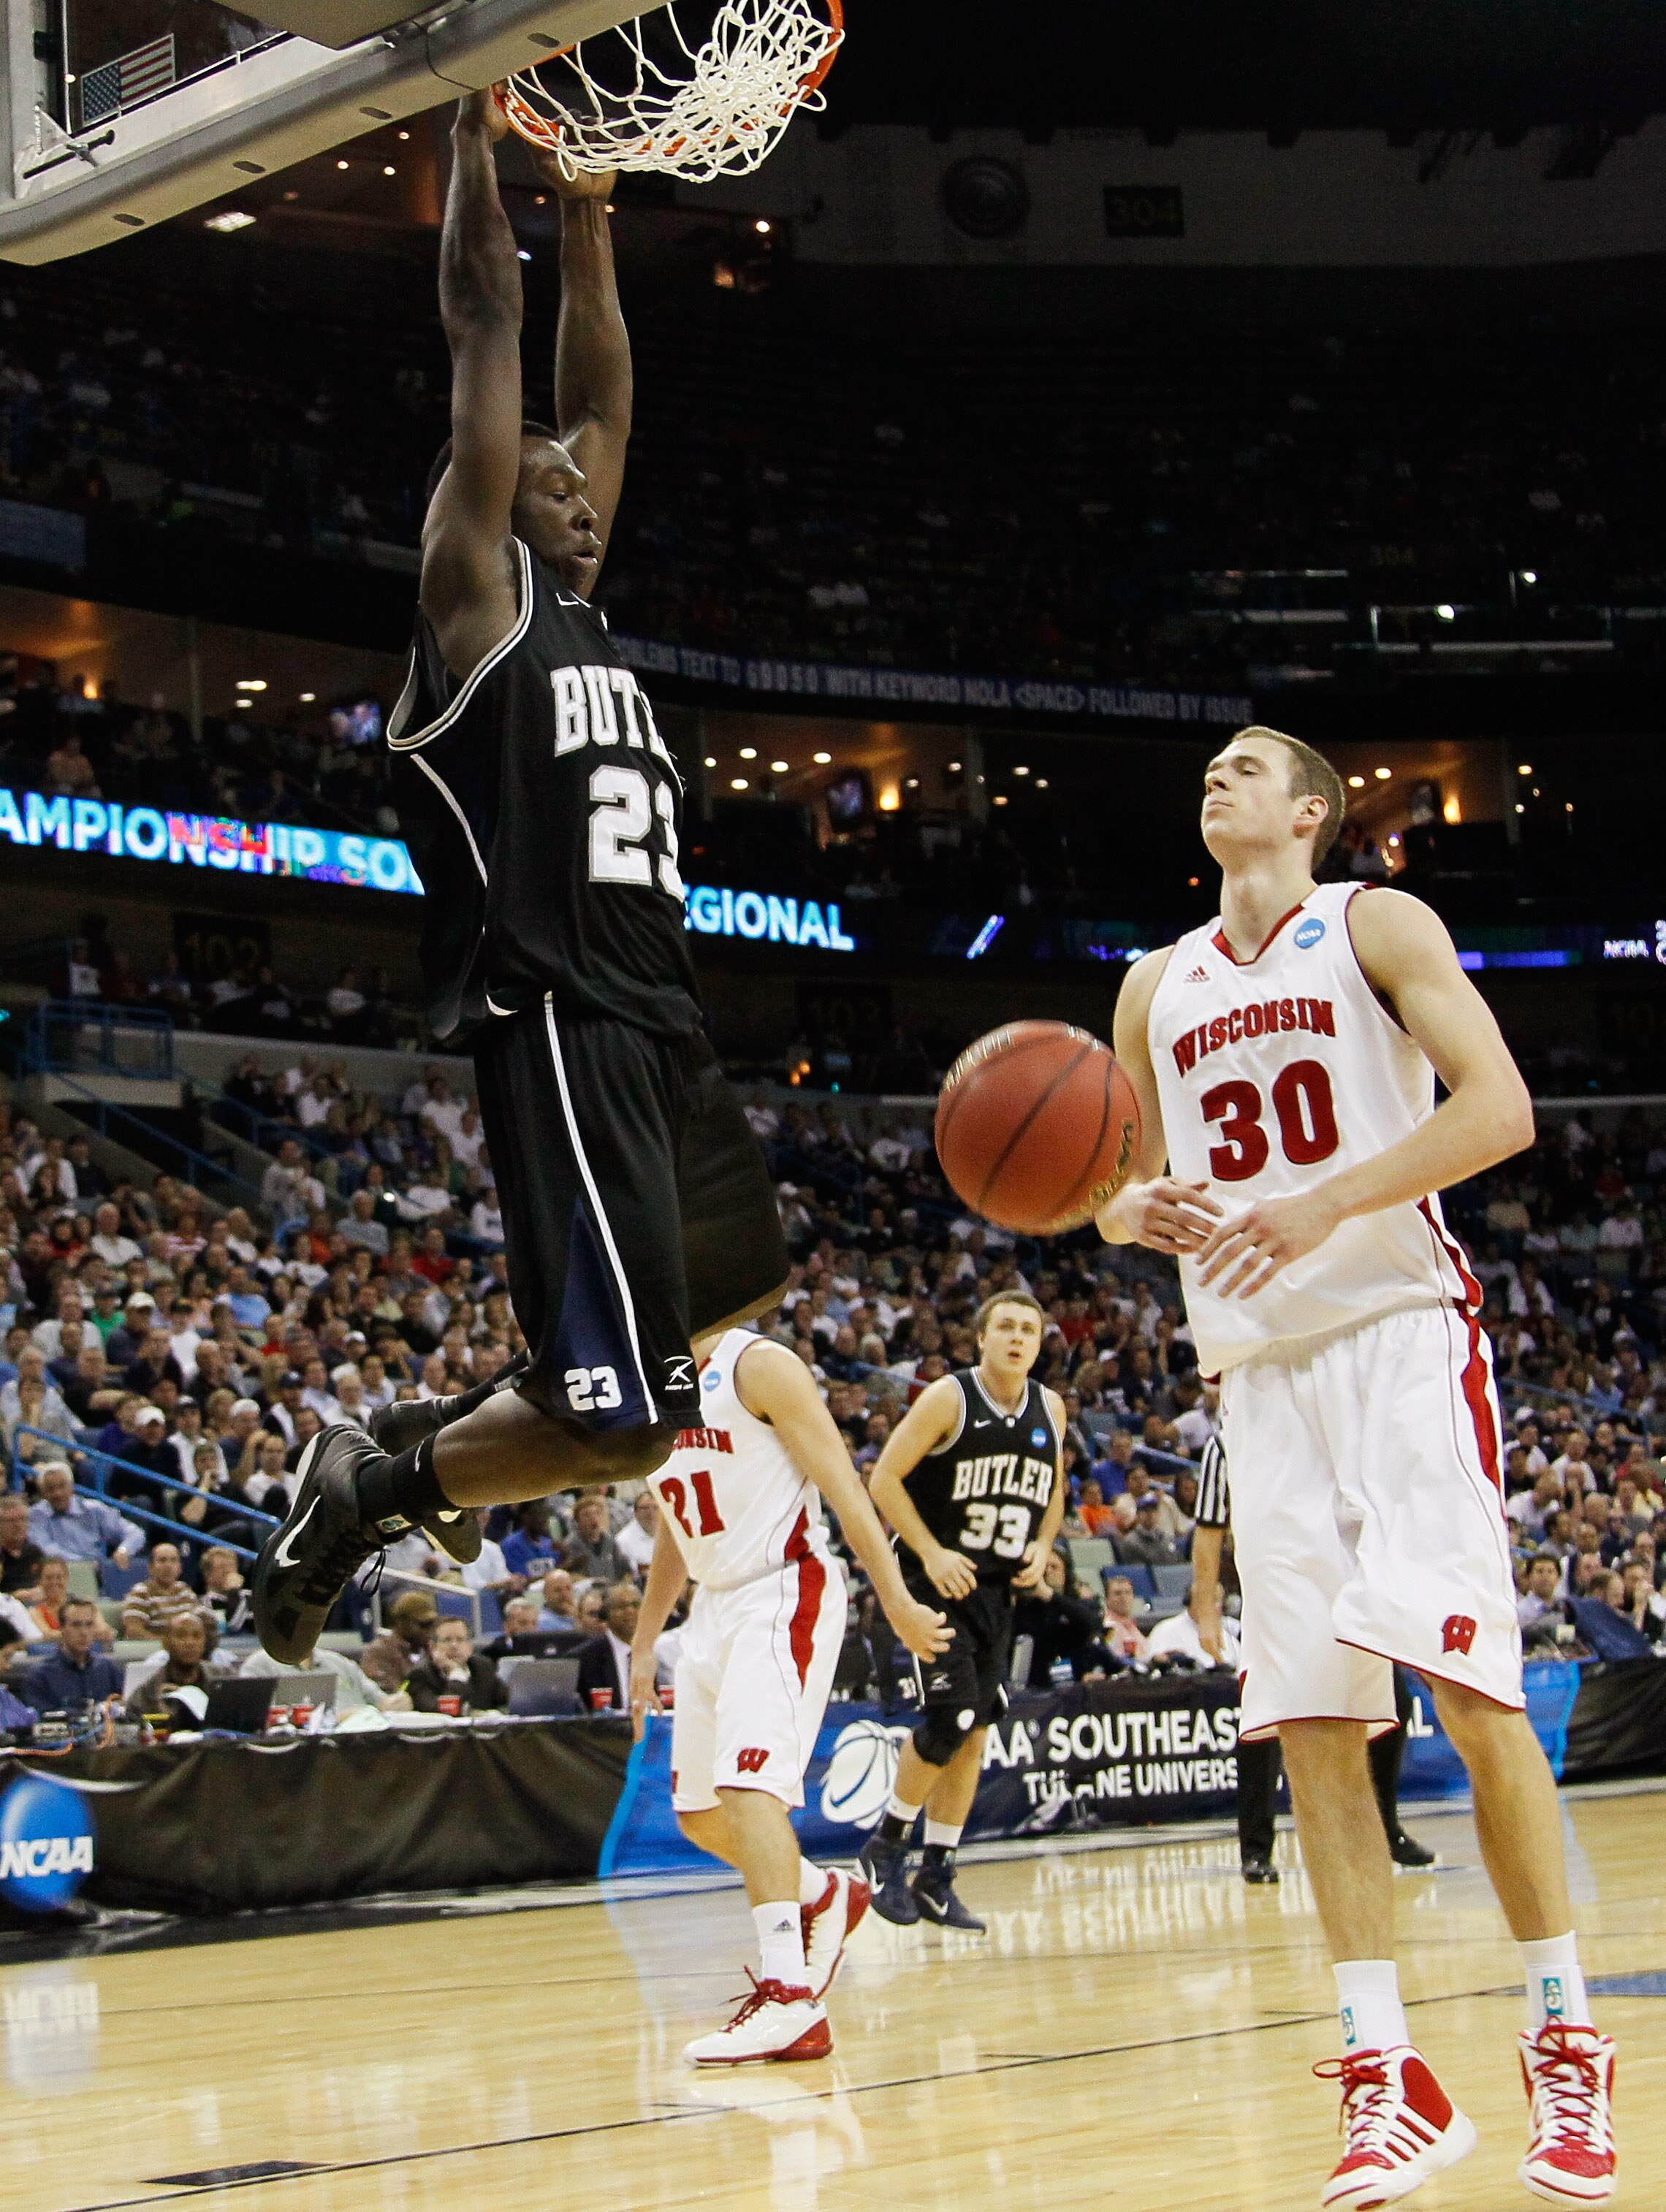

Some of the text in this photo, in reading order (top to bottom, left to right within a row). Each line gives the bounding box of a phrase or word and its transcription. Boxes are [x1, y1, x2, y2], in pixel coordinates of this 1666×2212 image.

[1108, 196, 1178, 227] 304
[681, 647, 716, 681] TEXT
[720, 655, 740, 684] TO
[825, 665, 872, 698] WITH
[876, 670, 961, 705] KEYWORD
[965, 678, 1011, 708] NOLA
[1089, 685, 1176, 720] FOLLOWED
[1179, 692, 1200, 721] BY
[1172, 997, 1336, 1079] WISCONSIN
[1200, 1059, 1340, 1181] 30
[564, 1365, 623, 1411] 23
[659, 1471, 726, 1539] 21
[952, 1453, 1053, 1509] BUTLER
[959, 1502, 1032, 1560] 33
[0, 1835, 94, 1880] NCAA
